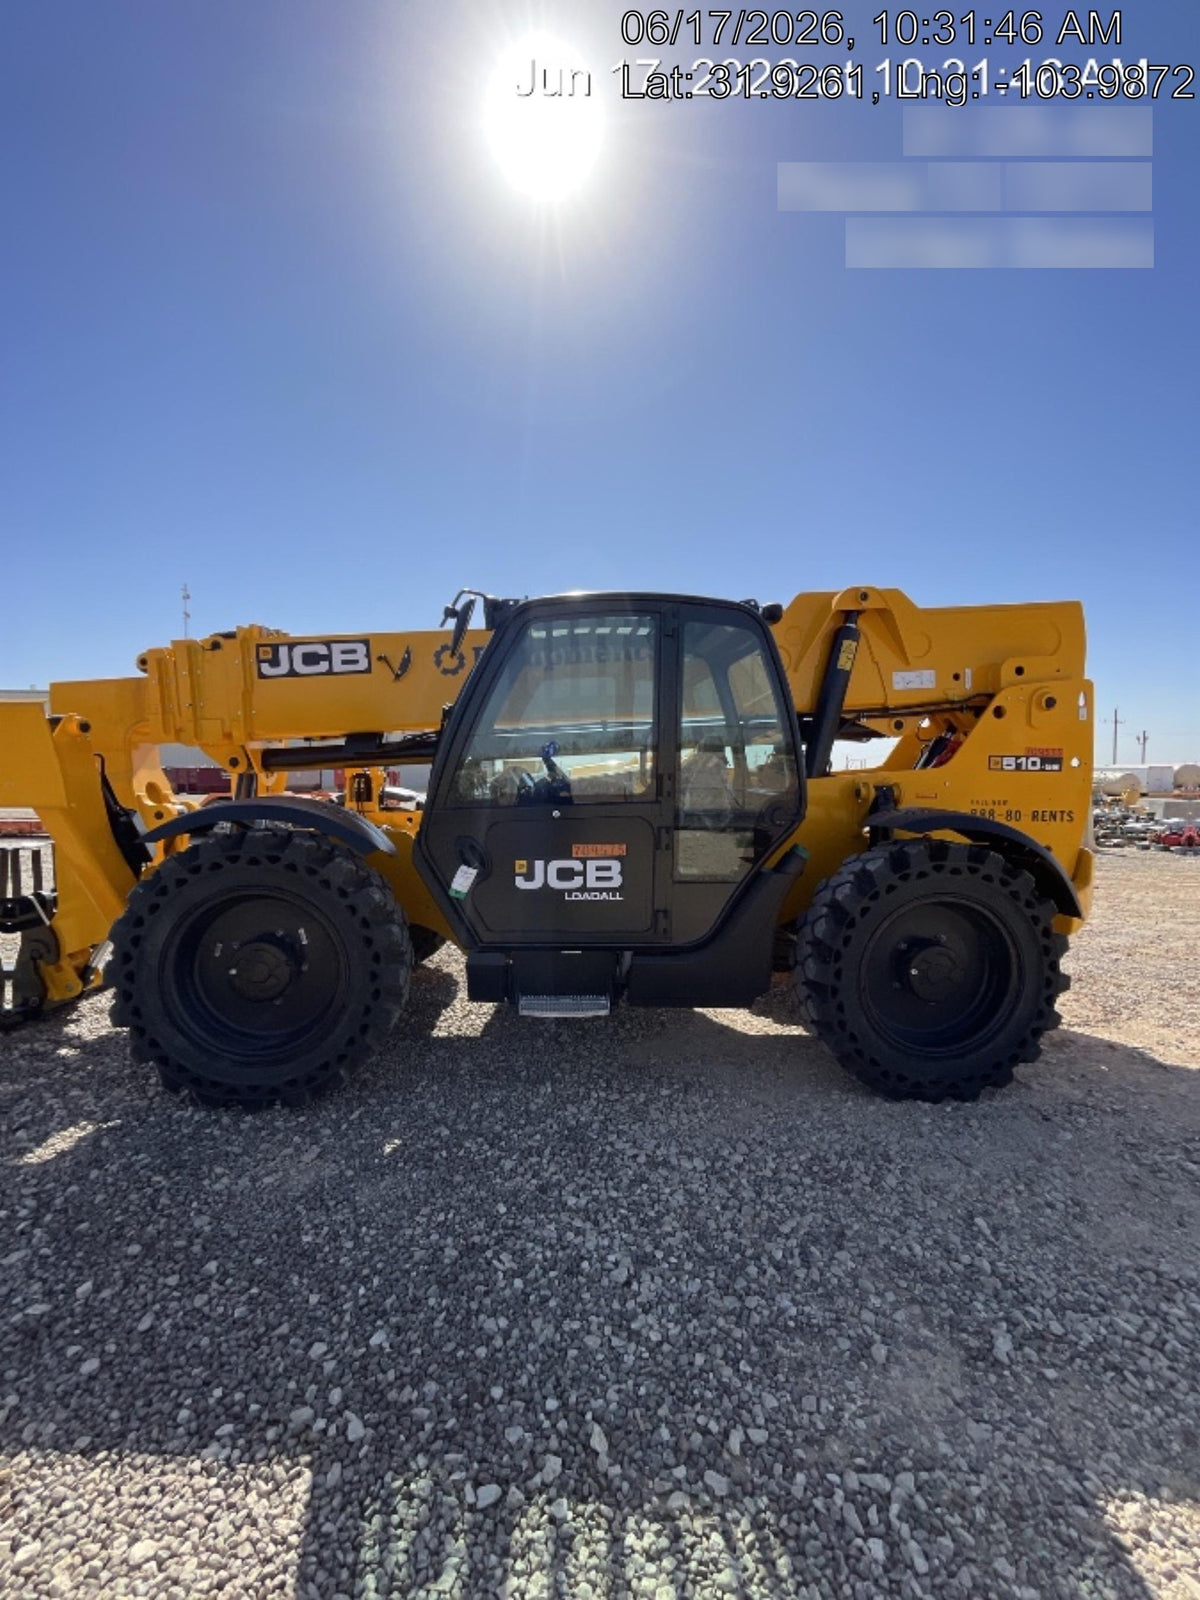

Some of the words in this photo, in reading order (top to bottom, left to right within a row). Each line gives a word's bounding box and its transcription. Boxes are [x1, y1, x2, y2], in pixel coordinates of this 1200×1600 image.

[260, 642, 369, 676] JCB
[515, 859, 623, 890] JCB
[564, 891, 624, 901] LOADALL
